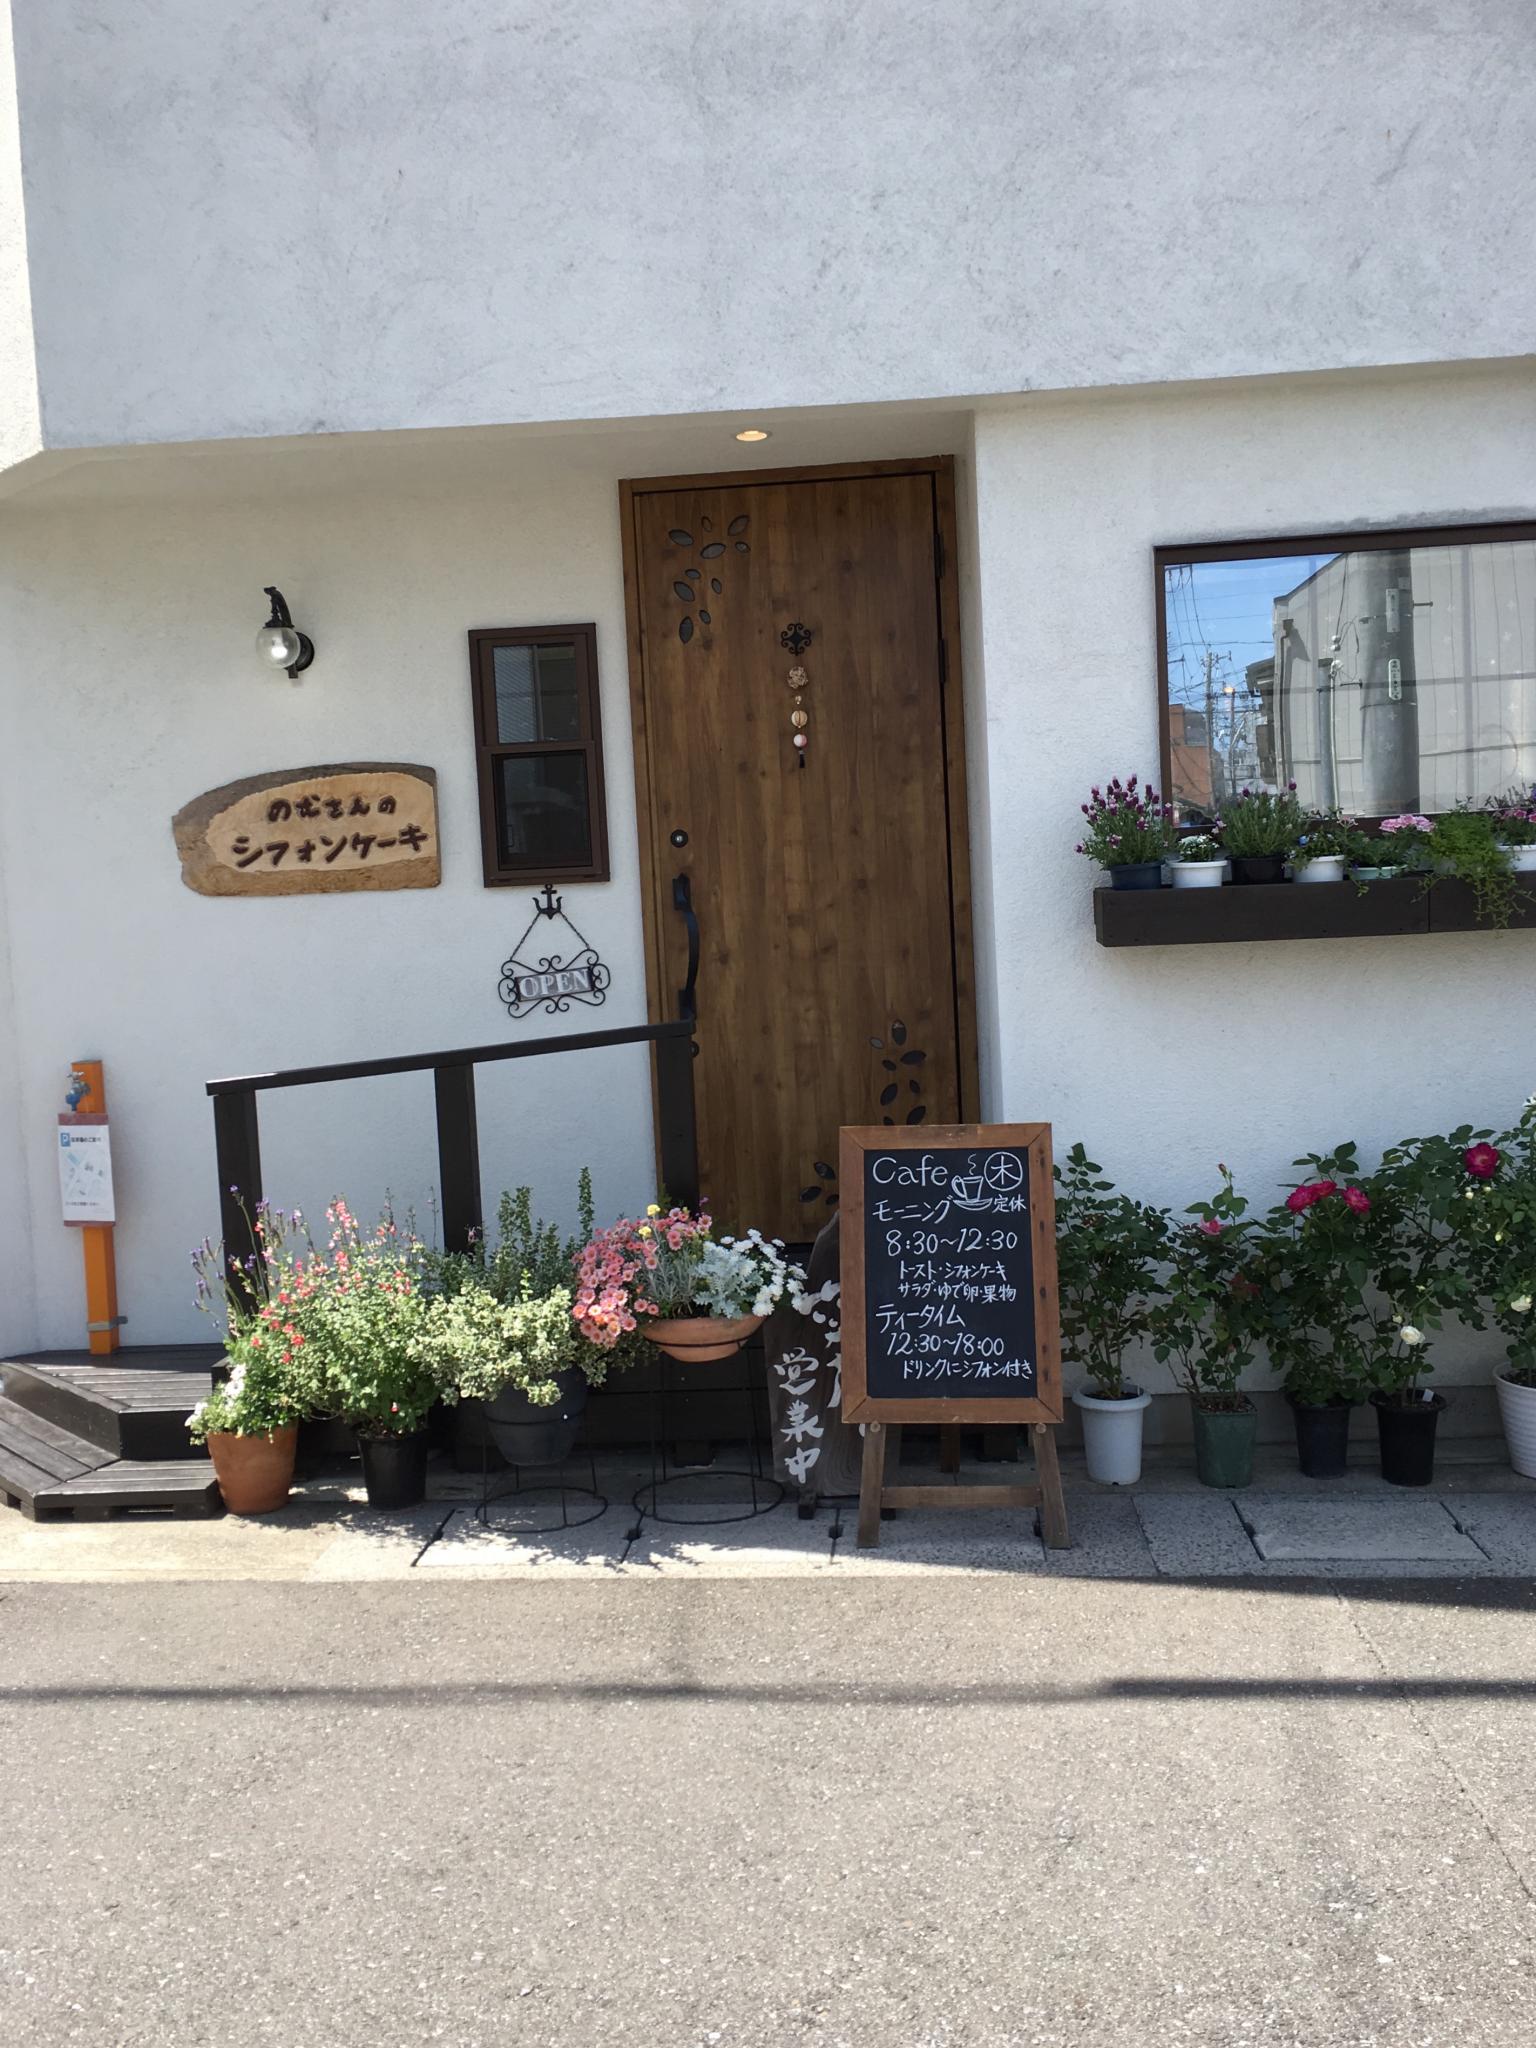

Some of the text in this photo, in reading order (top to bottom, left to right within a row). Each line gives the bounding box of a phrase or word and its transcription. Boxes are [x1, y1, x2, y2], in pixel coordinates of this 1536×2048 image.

[231, 824, 428, 868] シフォンケーキ
[518, 968, 590, 998] OPEN
[872, 1155, 948, 1186] Cafe
[872, 1195, 953, 1224] モーニング
[992, 1193, 1028, 1214] 定休
[876, 1303, 966, 1333] ティータイム
[904, 1358, 1033, 1380] ドリンクにシフォン付き
[774, 1347, 824, 1484] 営業中
